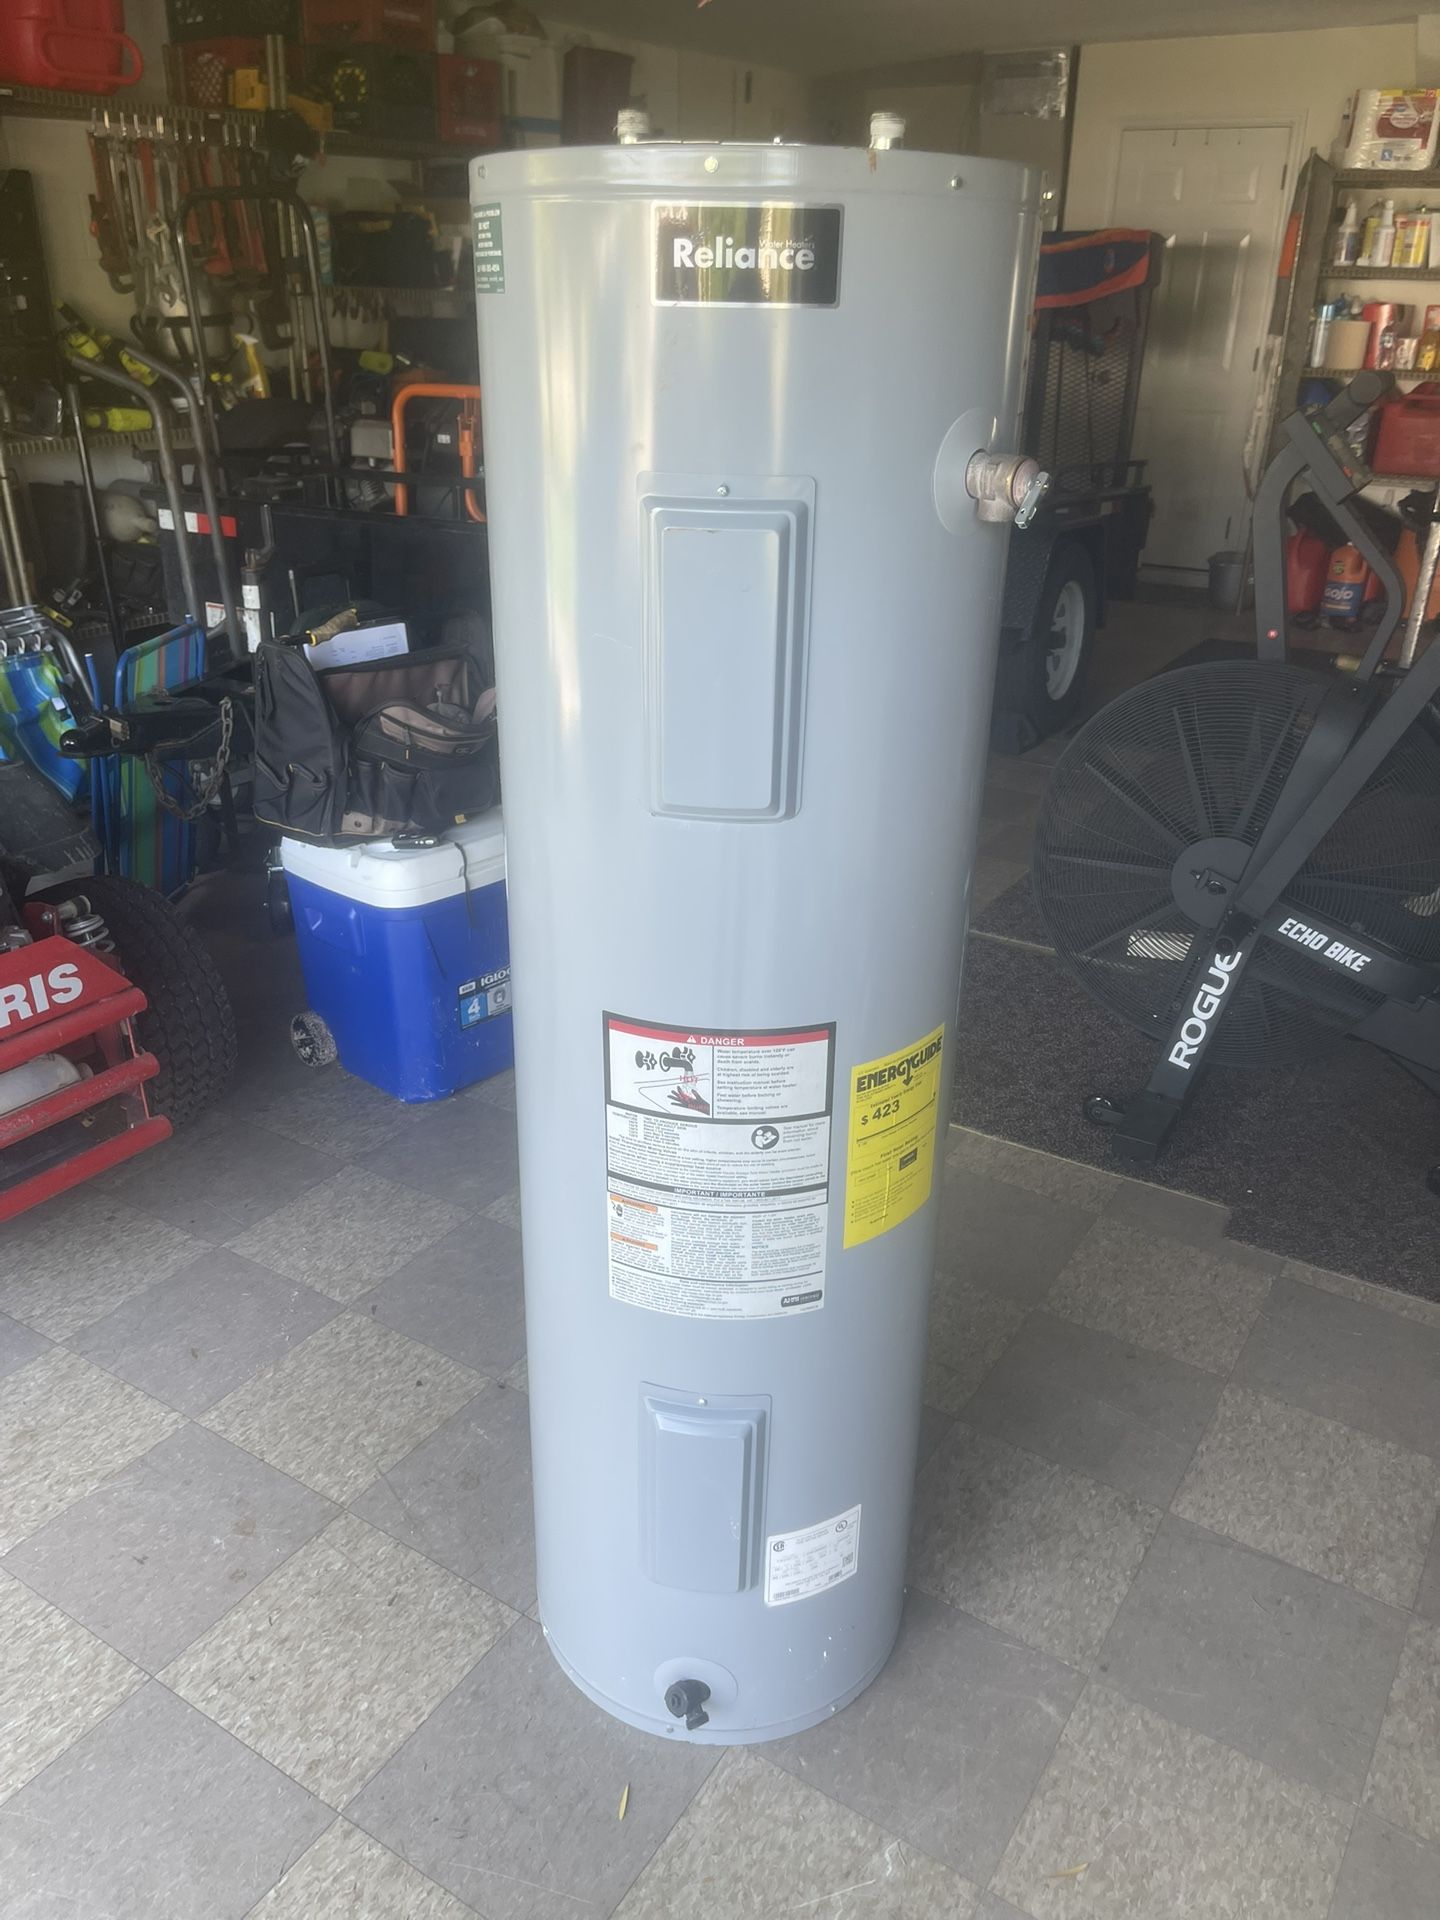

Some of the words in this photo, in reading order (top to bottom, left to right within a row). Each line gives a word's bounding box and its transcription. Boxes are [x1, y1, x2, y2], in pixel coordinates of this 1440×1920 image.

[674, 236, 815, 270] Reliance
[759, 239, 784, 249] Water
[786, 240, 815, 249] Heaters
[1278, 918, 1329, 950] ECHO
[1324, 941, 1372, 972] BIKE
[468, 998, 480, 1014] 4
[1168, 951, 1242, 1069] ROGUE
[701, 1037, 745, 1045] DANGER
[856, 1035, 942, 1093] ENERGYGUIDE
[872, 1100, 900, 1120] 423
[674, 1188, 714, 1197] IMPORTANT
